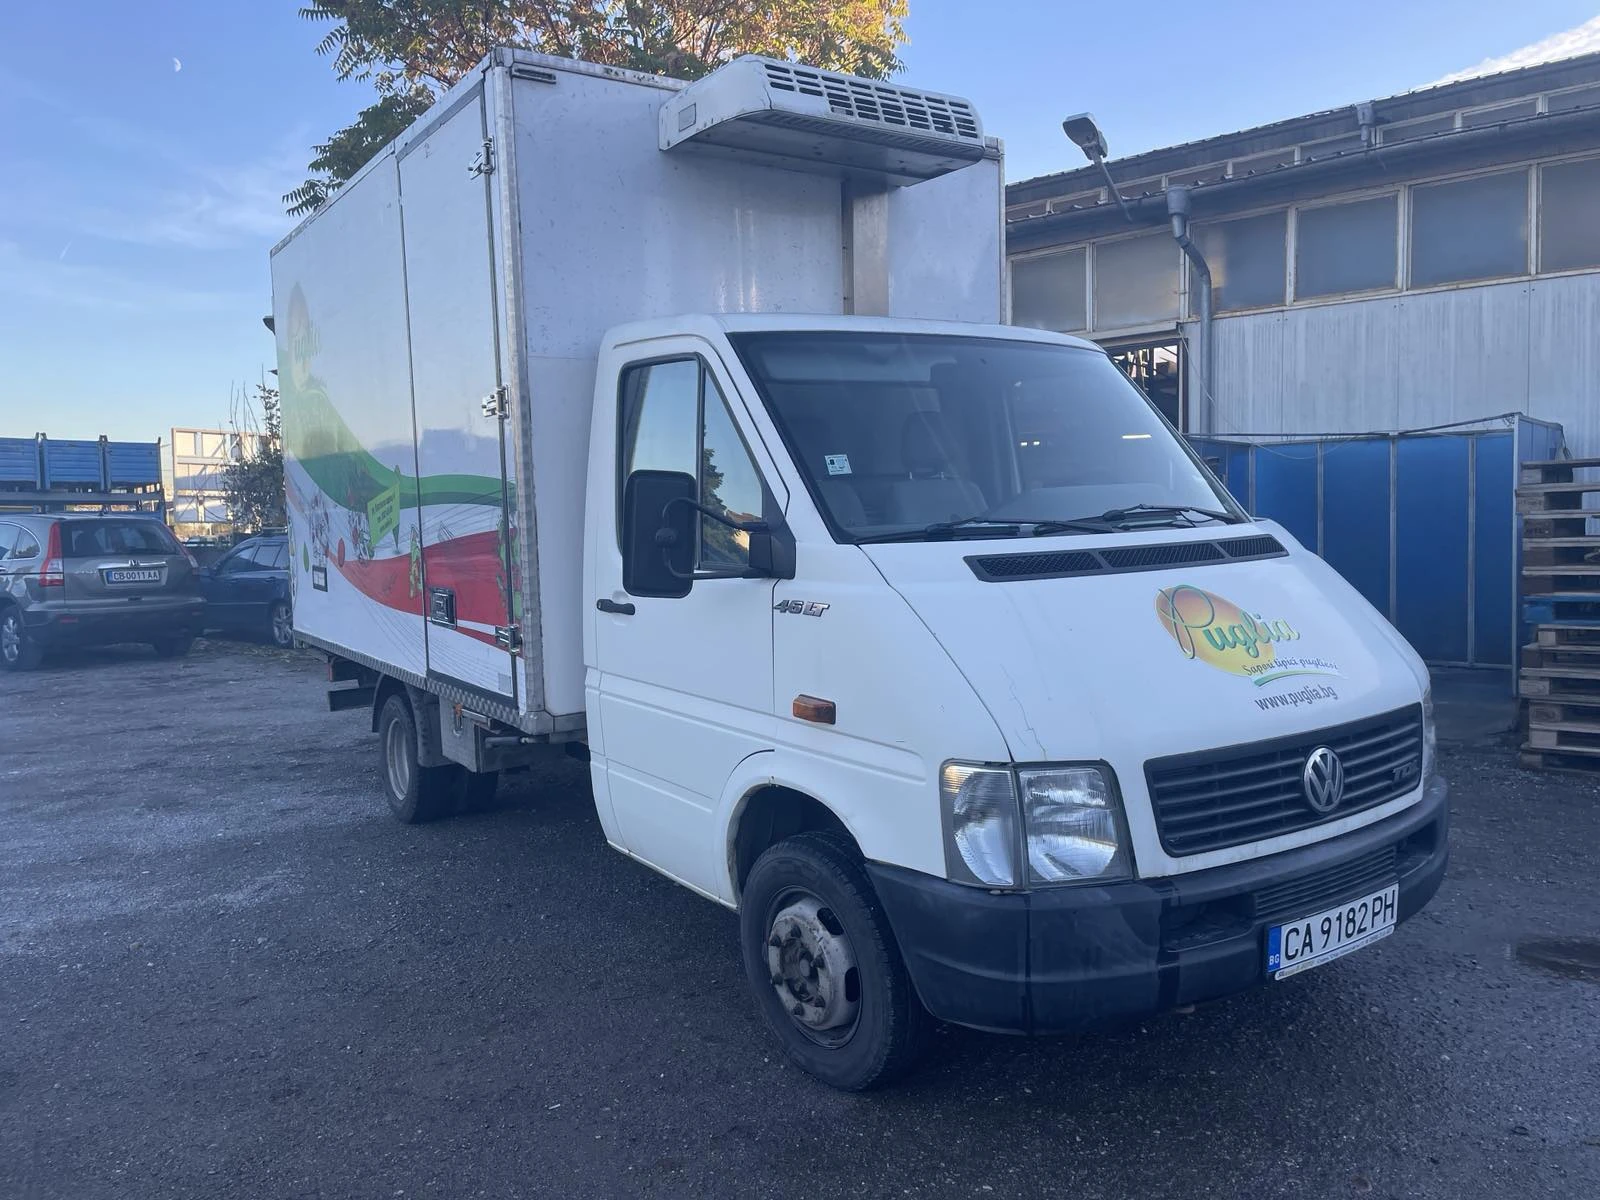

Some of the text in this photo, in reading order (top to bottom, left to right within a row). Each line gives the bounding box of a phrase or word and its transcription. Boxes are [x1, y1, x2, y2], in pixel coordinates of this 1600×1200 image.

[147, 571, 159, 579] AA
[1158, 584, 1301, 659] Puglia
[1242, 660, 1273, 676] Sapori
[1274, 657, 1297, 669] tipici
[1254, 684, 1339, 711] www.puglia.bg
[1285, 924, 1314, 961] CA
[1321, 903, 1368, 948] 9182
[1269, 953, 1280, 966] BG
